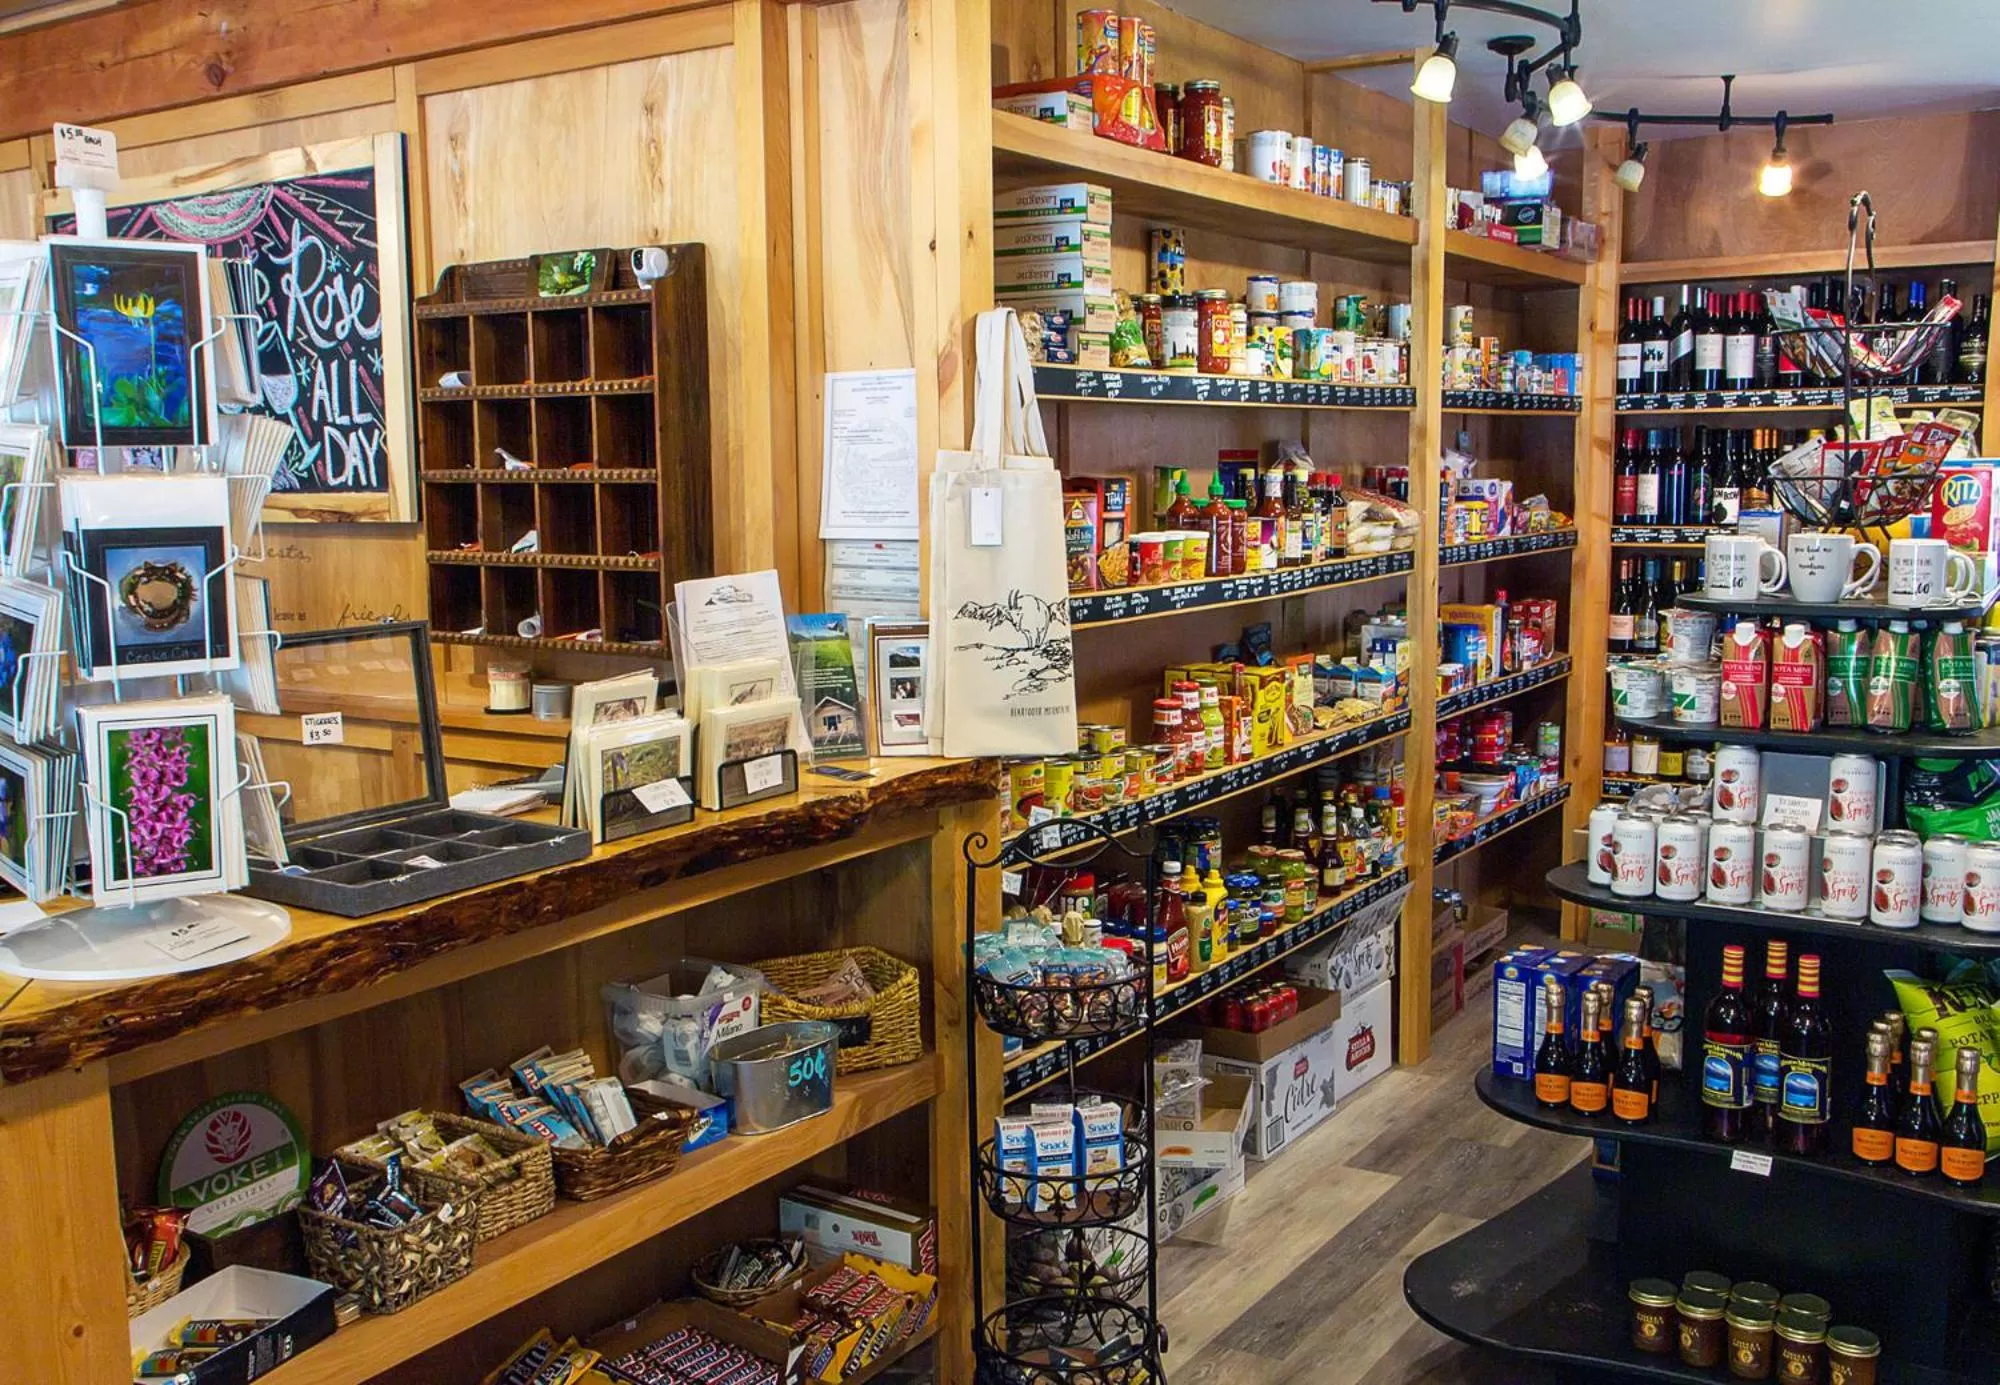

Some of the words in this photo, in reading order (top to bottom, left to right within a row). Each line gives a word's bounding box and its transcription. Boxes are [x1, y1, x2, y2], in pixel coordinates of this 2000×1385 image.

[269, 217, 382, 349] Rosé
[312, 358, 373, 425] ALL
[323, 425, 381, 488] DAY
[1945, 478, 1978, 505] RITZ
[788, 1048, 826, 1088] 50¢
[1284, 1070, 1318, 1125] Cidre
[1040, 1140, 1069, 1152] Snack
[1088, 1122, 1118, 1135] Snack
